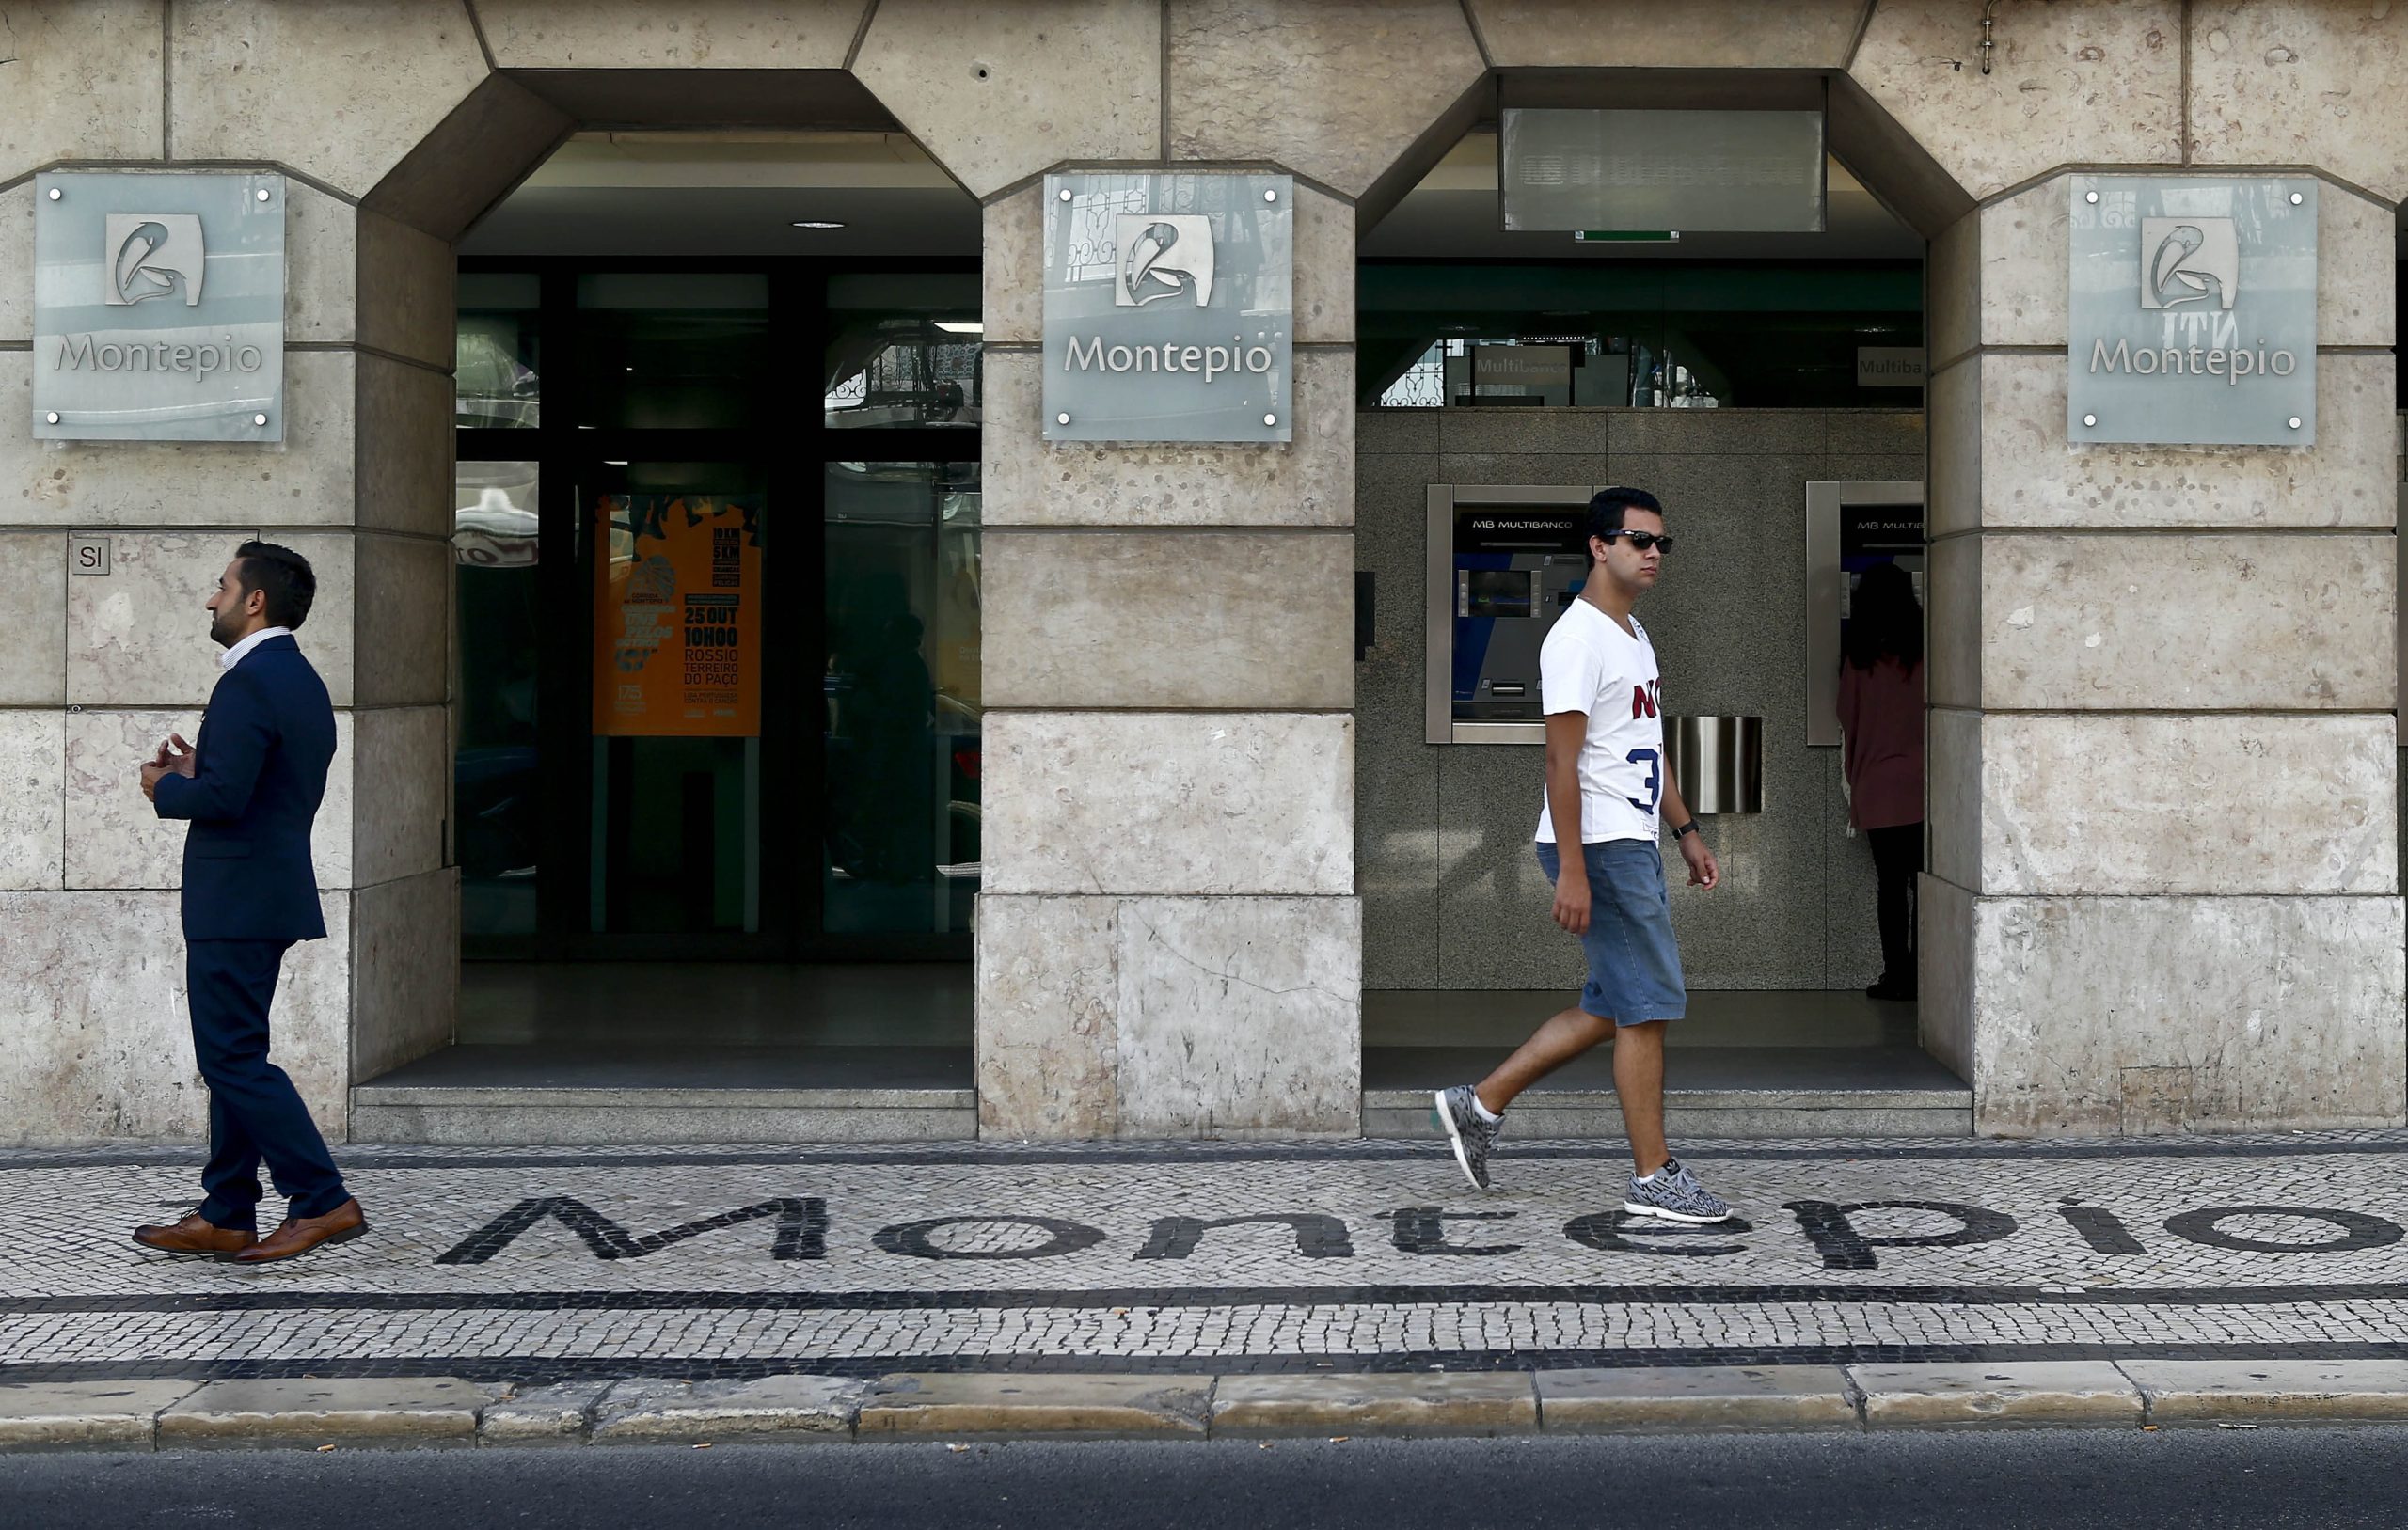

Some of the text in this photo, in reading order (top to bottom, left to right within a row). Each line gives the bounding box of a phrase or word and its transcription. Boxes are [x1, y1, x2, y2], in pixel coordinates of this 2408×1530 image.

[54, 334, 262, 383] Montepio
[1064, 336, 1272, 383] Montepio
[1860, 360, 1922, 374] Multiba
[2089, 338, 2296, 386] Montepio
[79, 547, 102, 568] SI
[684, 627, 738, 648] 10H00
[685, 649, 738, 662] ROSSIO
[684, 663, 738, 673] TERREIRO
[684, 673, 738, 687] DO PAÇO
[434, 1196, 2406, 1270] Montepio
